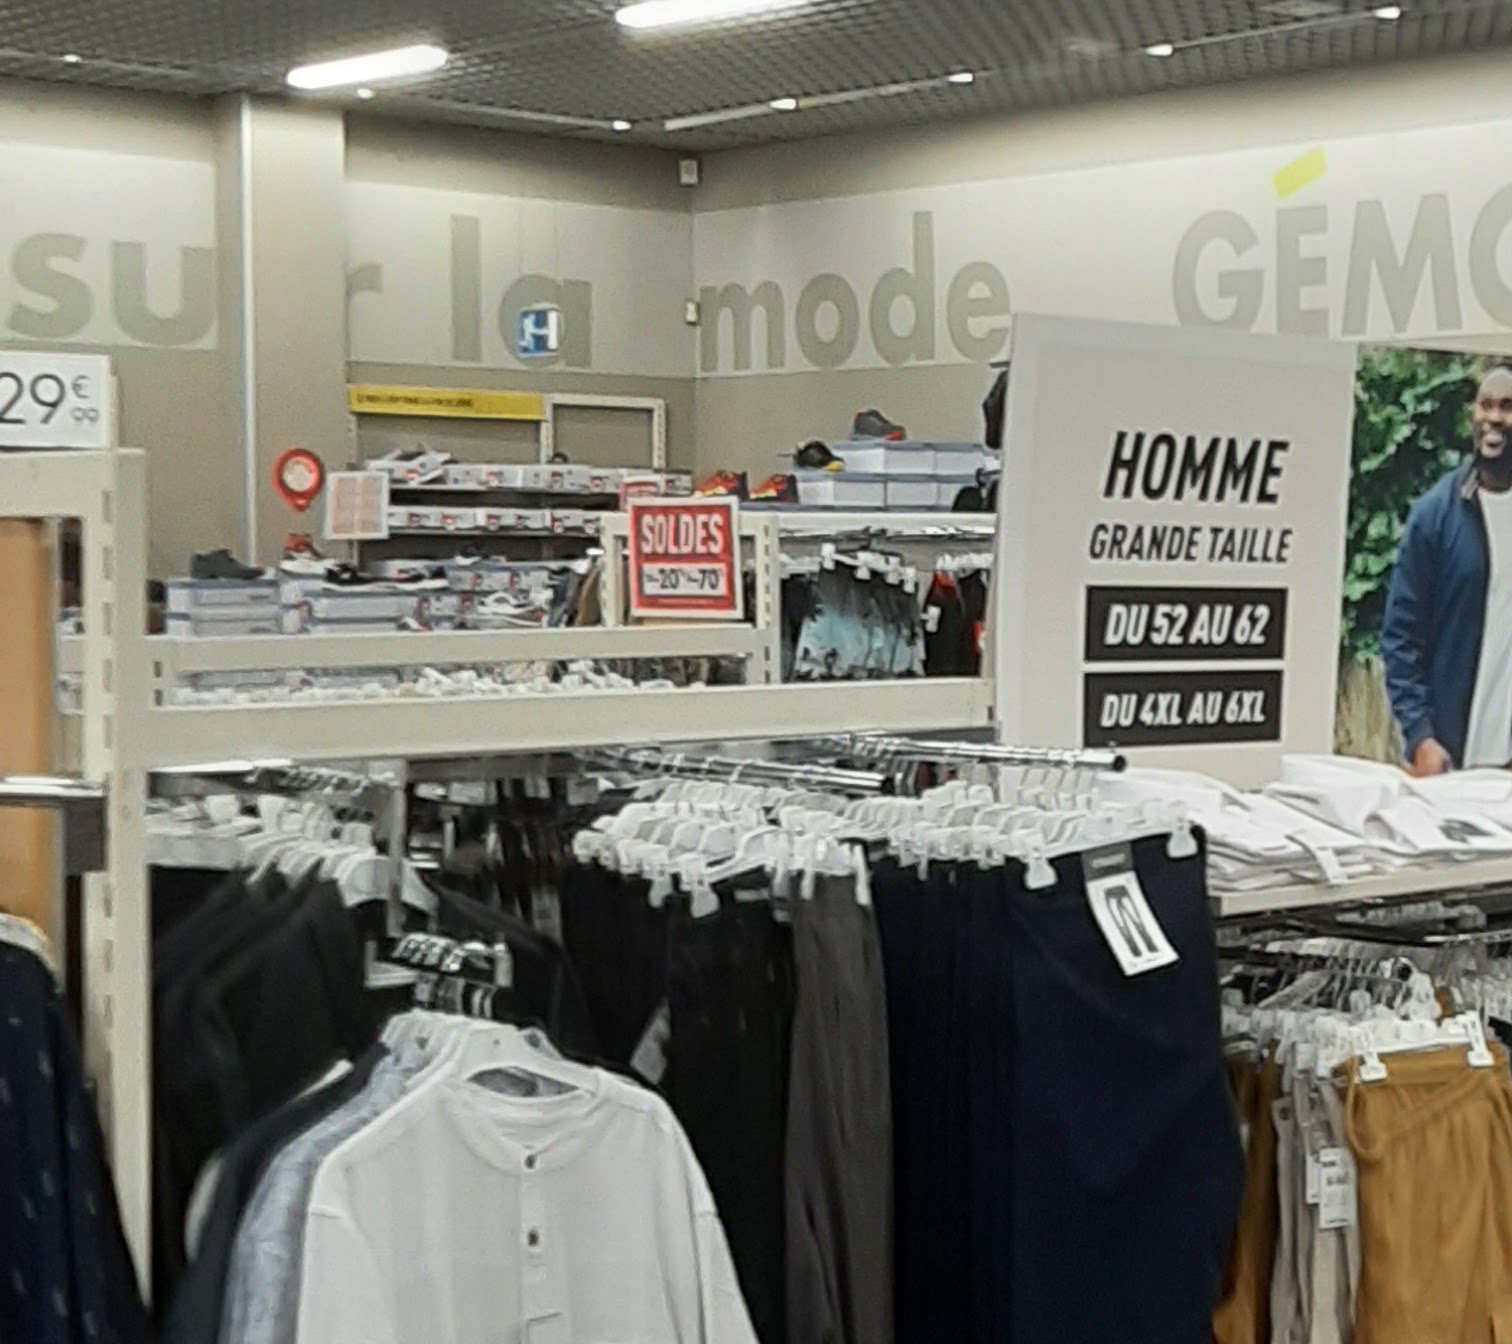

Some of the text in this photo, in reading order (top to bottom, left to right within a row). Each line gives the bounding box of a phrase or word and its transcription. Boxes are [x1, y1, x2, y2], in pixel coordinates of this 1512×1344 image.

[700, 211, 1010, 370] mode
[1104, 431, 1289, 504] HOMME
[641, 513, 723, 554] SOLDES
[1089, 524, 1293, 563] GRANDE TAILLE
[1103, 603, 1271, 645] DU 52 AU 62
[1101, 690, 1265, 728] DU 4XL AU 6XL
